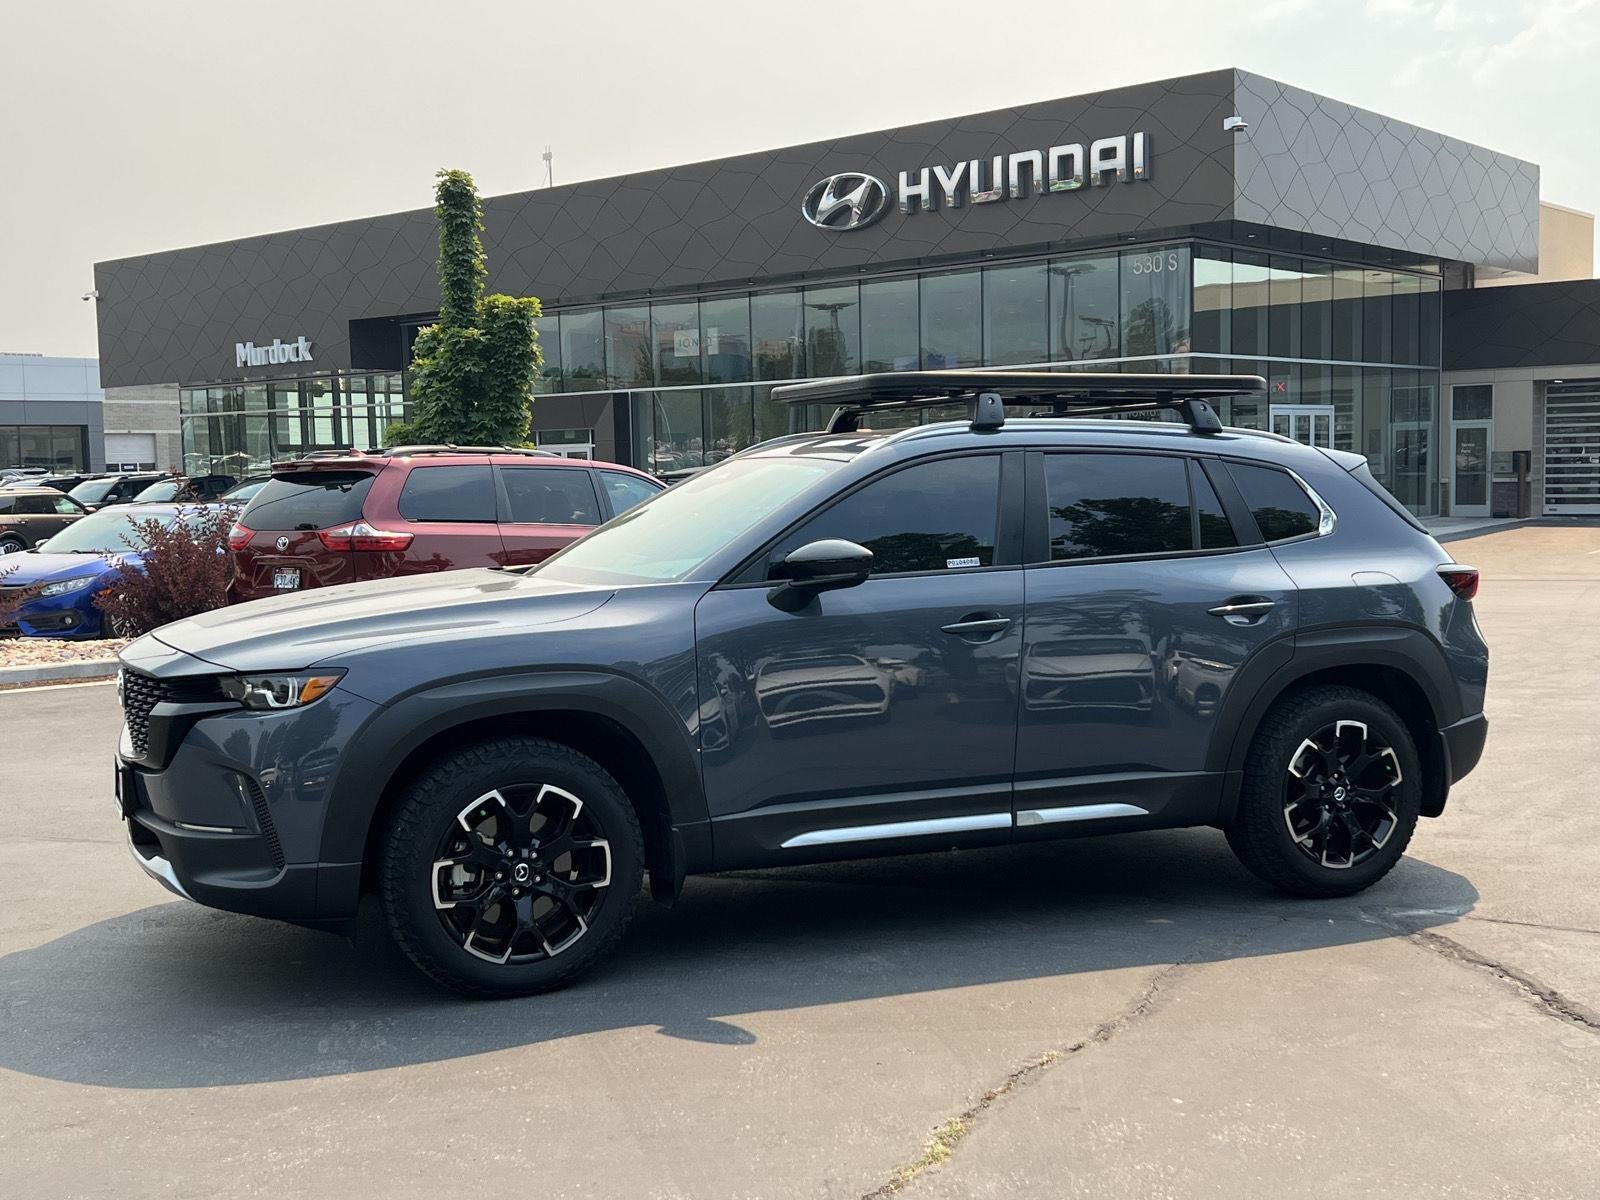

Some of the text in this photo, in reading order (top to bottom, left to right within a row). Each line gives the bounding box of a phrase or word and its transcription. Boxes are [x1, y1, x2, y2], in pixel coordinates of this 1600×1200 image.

[899, 131, 1150, 214] HYUNDAI
[1133, 253, 1178, 275] 530 S
[235, 335, 314, 368] Murdock
